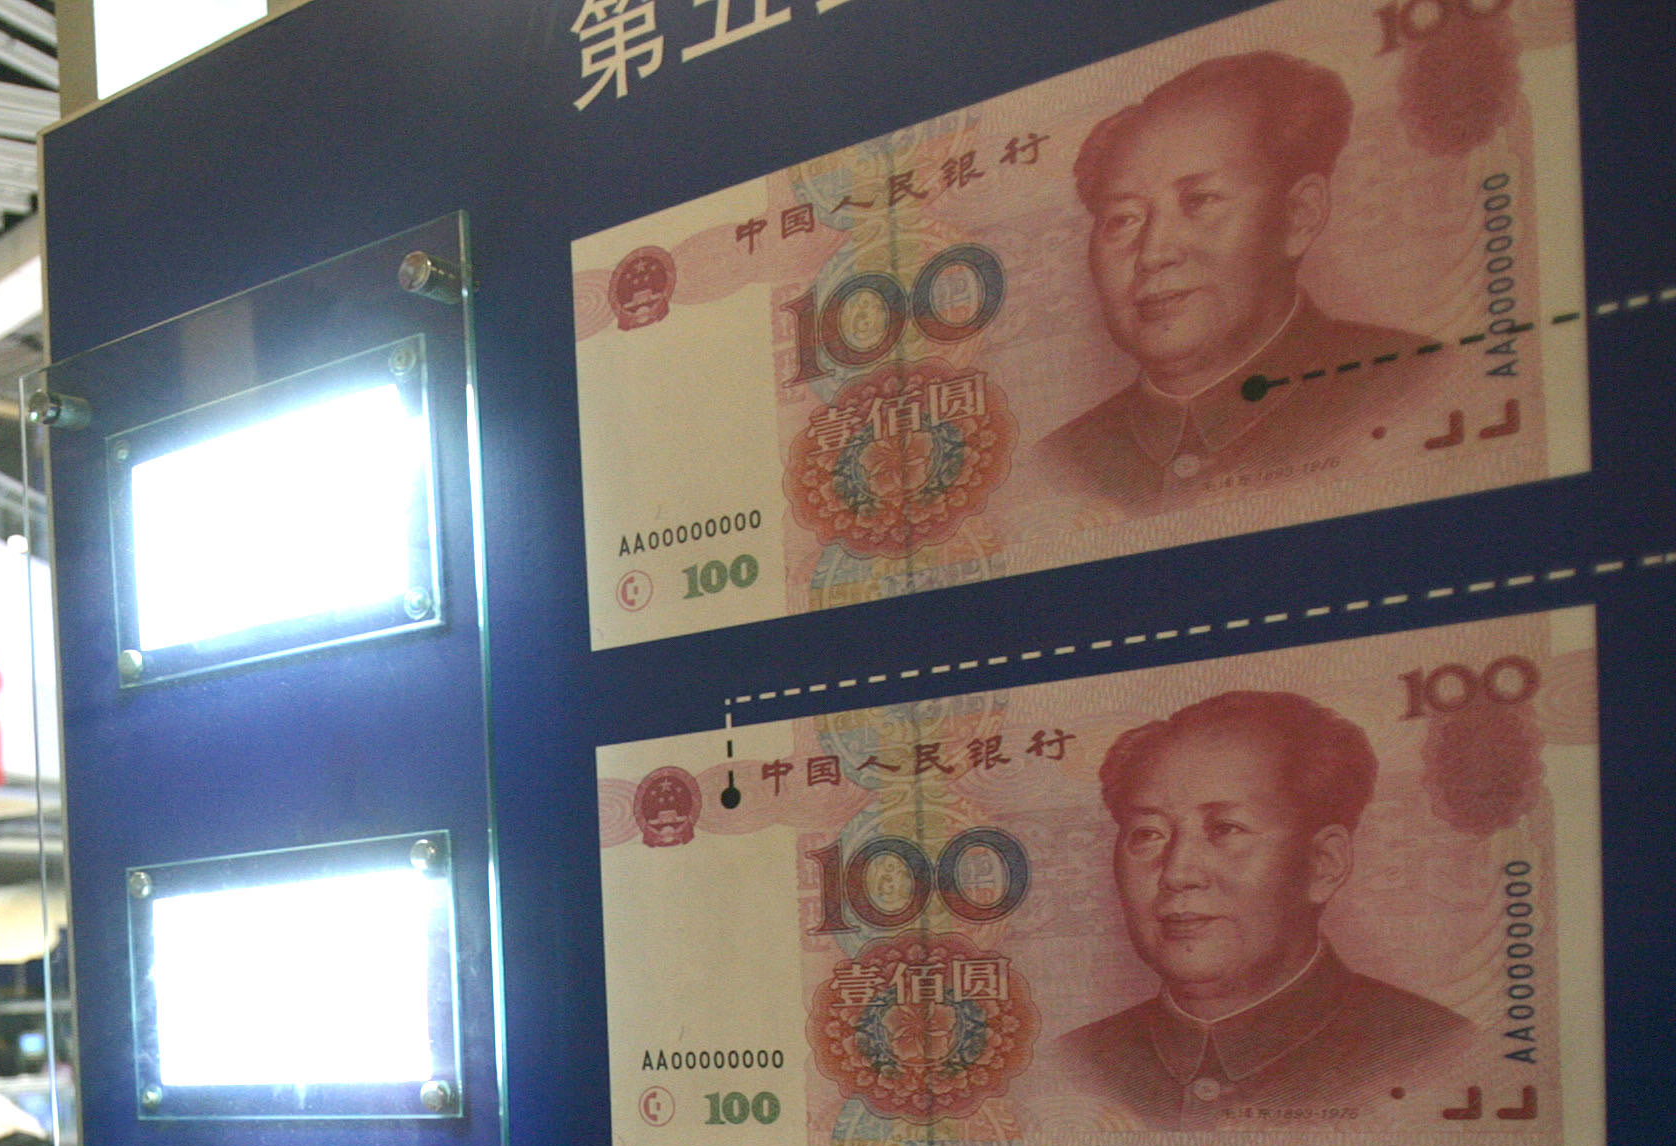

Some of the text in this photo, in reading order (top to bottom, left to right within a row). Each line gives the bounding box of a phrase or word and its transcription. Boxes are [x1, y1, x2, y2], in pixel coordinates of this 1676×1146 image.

[735, 131, 1051, 255] 中国人民银行
[1484, 173, 1519, 377] AA00000000
[780, 243, 1008, 390] 100
[808, 370, 989, 455] 壹佰圆
[618, 510, 762, 557] AA00000000
[681, 553, 759, 600] 100
[1398, 654, 1542, 722] 100
[761, 729, 1076, 797] 中国人民银行
[804, 826, 1030, 937] 100
[830, 957, 1011, 1008] 壹佰圆
[1504, 861, 1536, 1064] AA00000000
[641, 1049, 784, 1071] AA00000000
[703, 1091, 781, 1125] 100
